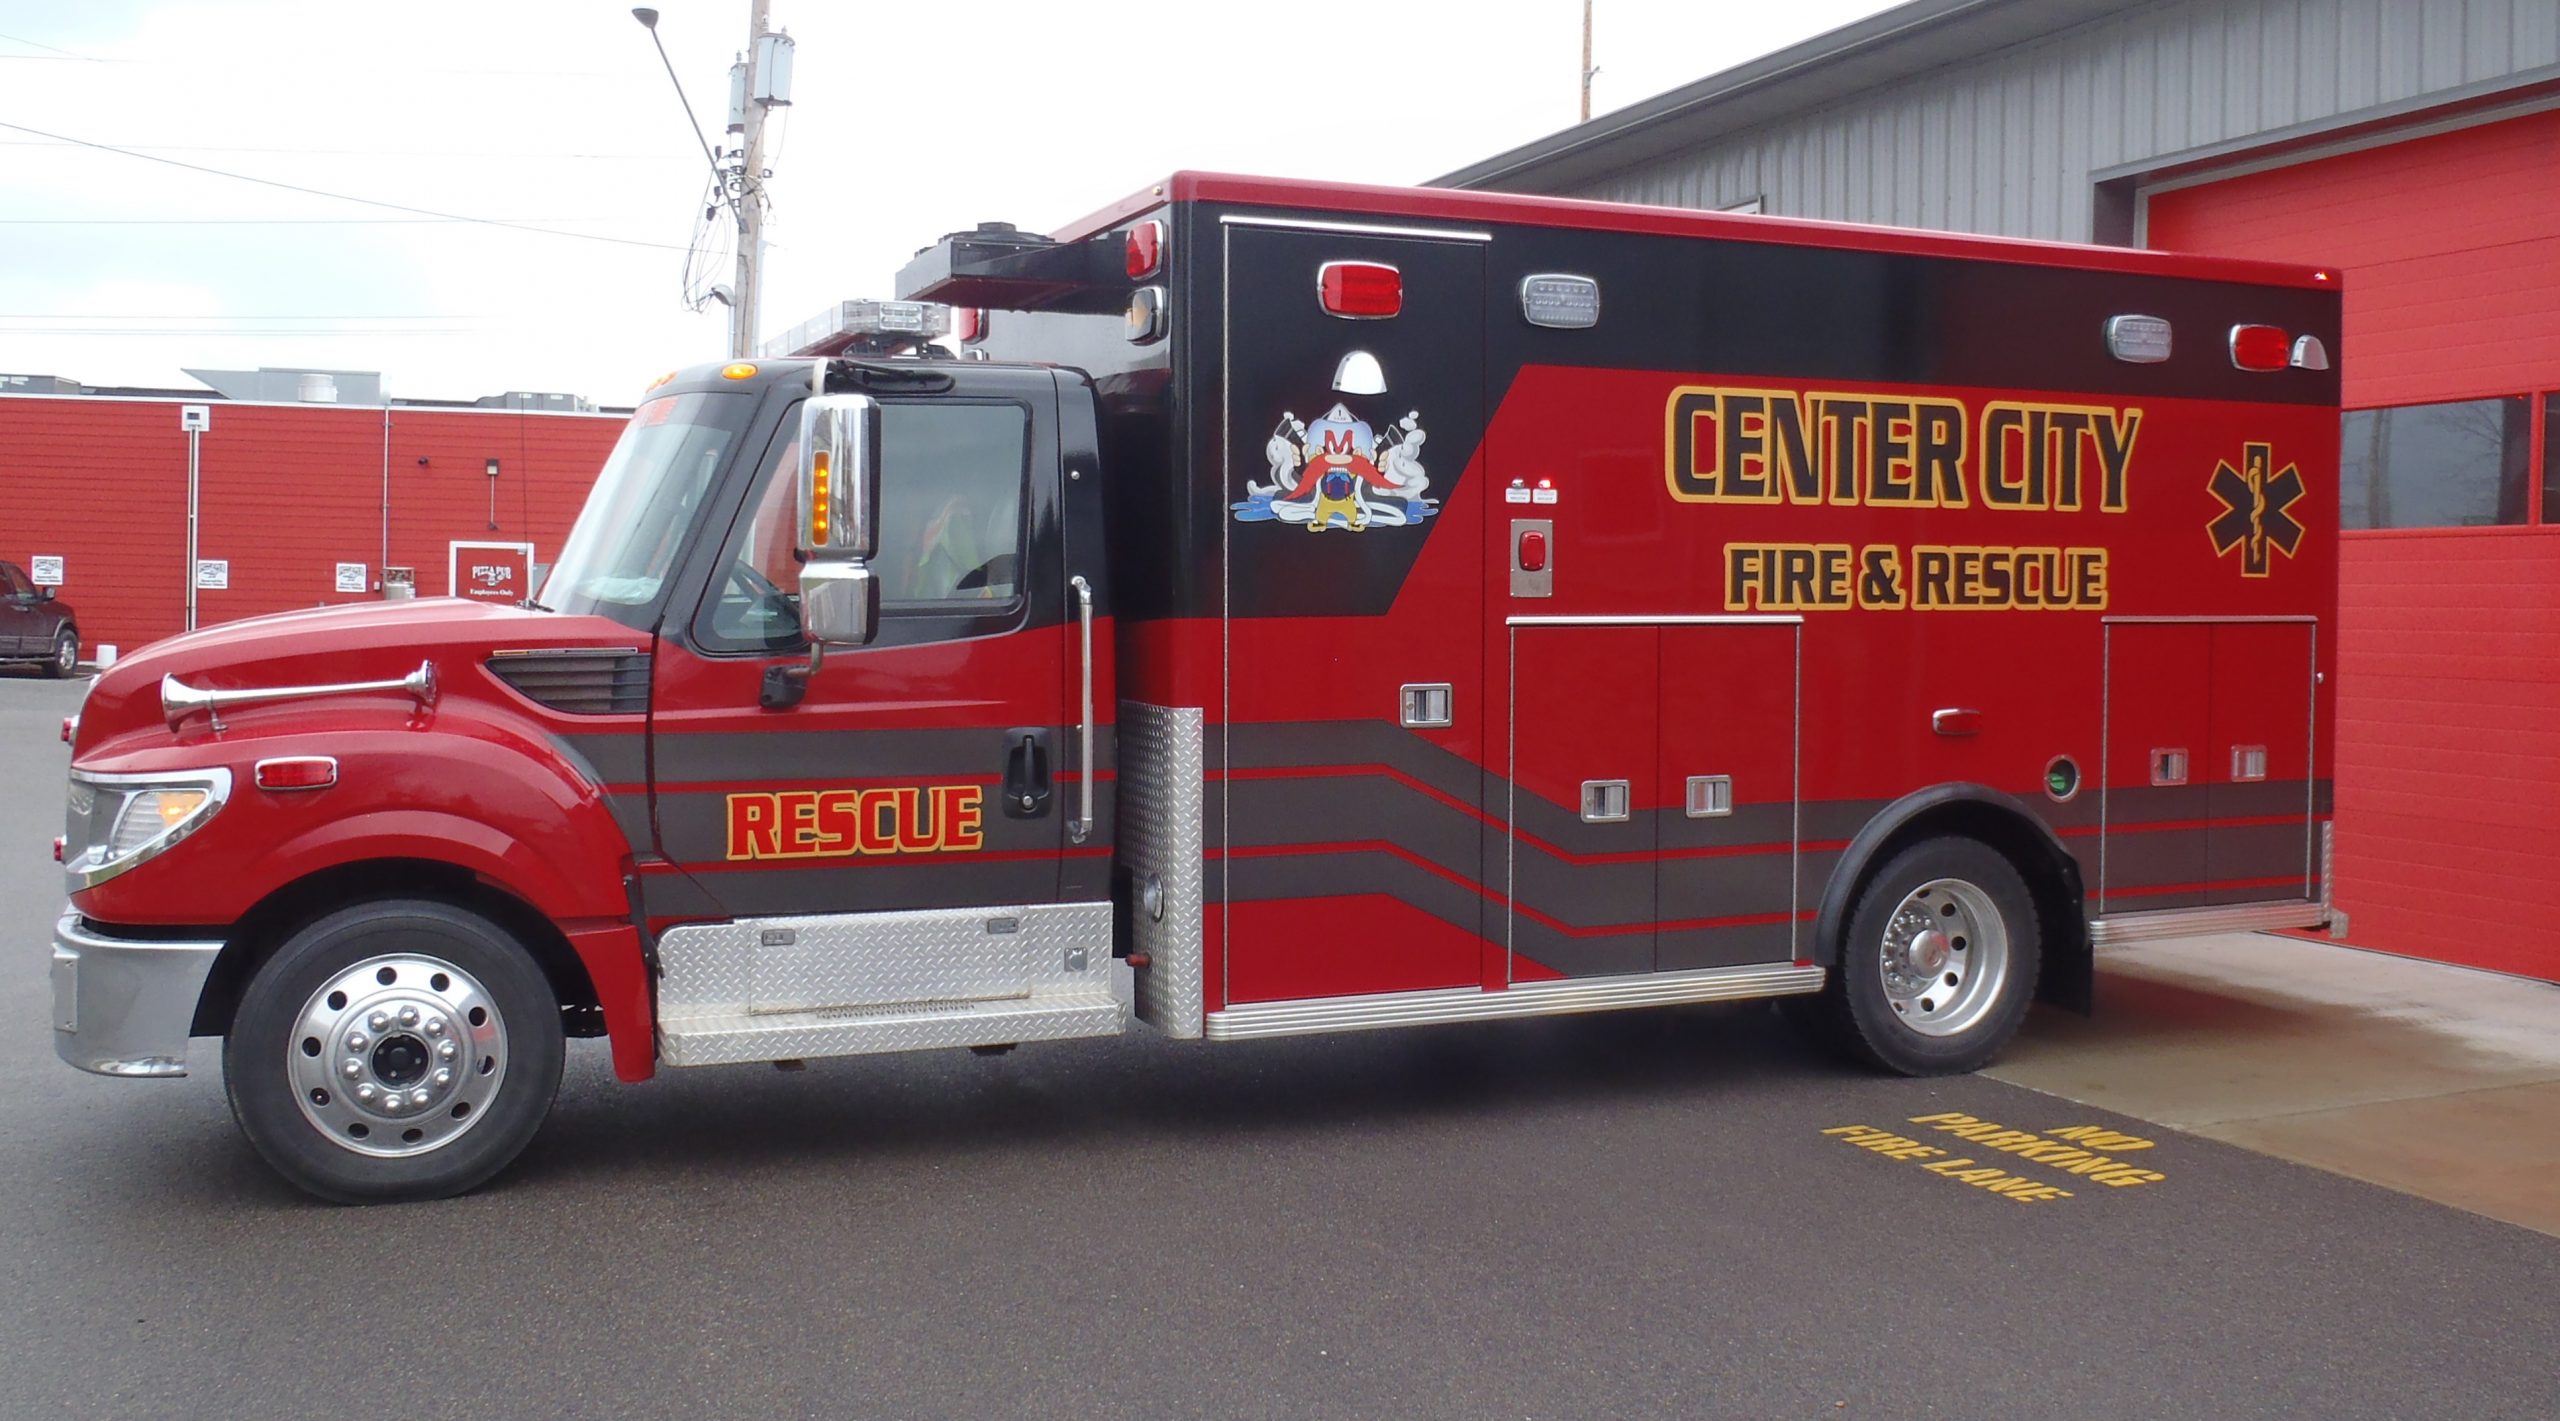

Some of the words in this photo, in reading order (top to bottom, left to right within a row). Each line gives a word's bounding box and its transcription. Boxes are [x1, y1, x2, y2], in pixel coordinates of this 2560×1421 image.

[1665, 385, 1970, 509] CENTER
[1979, 399, 2143, 513] CITY
[1724, 542, 1852, 610] FIRE
[1859, 543, 1906, 610] &
[1911, 546, 2109, 611] RESCUE
[726, 785, 983, 860] RESCUE
[1820, 1125, 1947, 1160] FIRE
[1920, 1158, 2074, 1201] LANE
[1907, 1112, 2166, 1187] PARKING
[2043, 1126, 2156, 1151] NO
